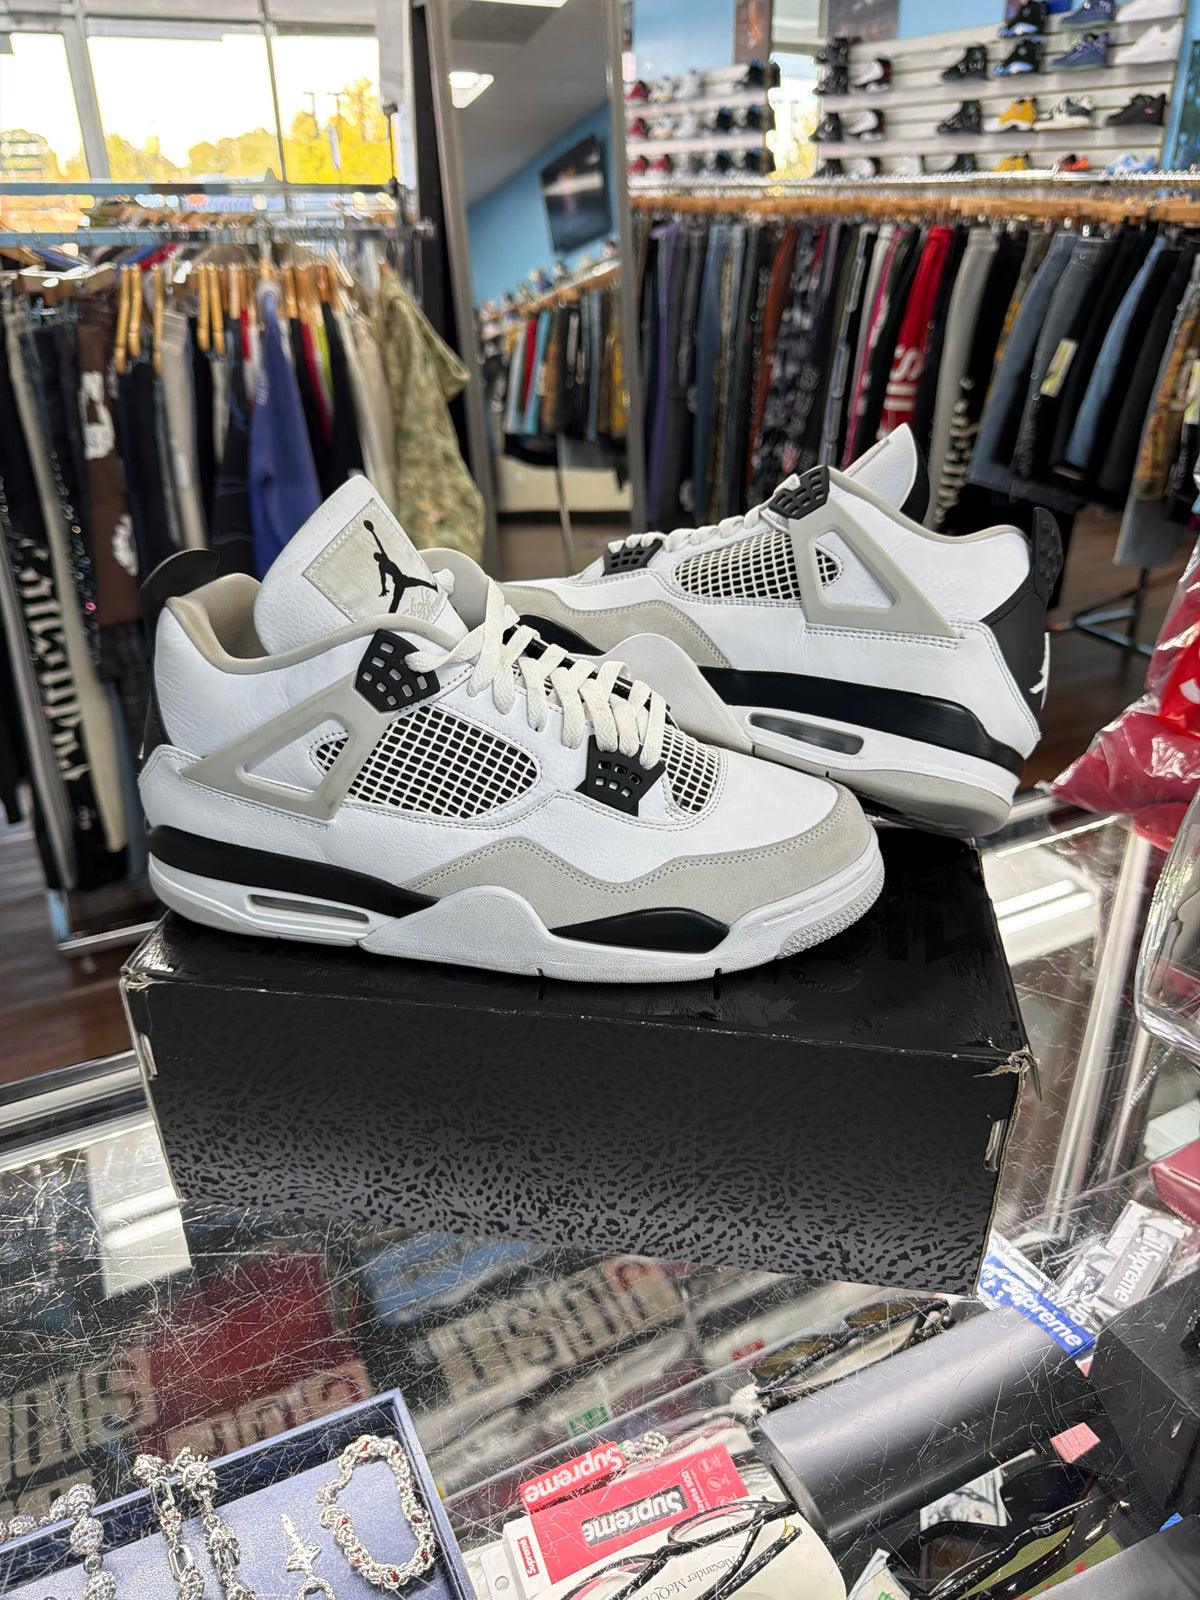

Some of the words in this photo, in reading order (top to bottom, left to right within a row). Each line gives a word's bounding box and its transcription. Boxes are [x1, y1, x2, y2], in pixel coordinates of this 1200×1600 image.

[524, 1446, 623, 1503] Supreme
[582, 1490, 684, 1541] Supreme
[519, 1538, 538, 1576] Supreme
